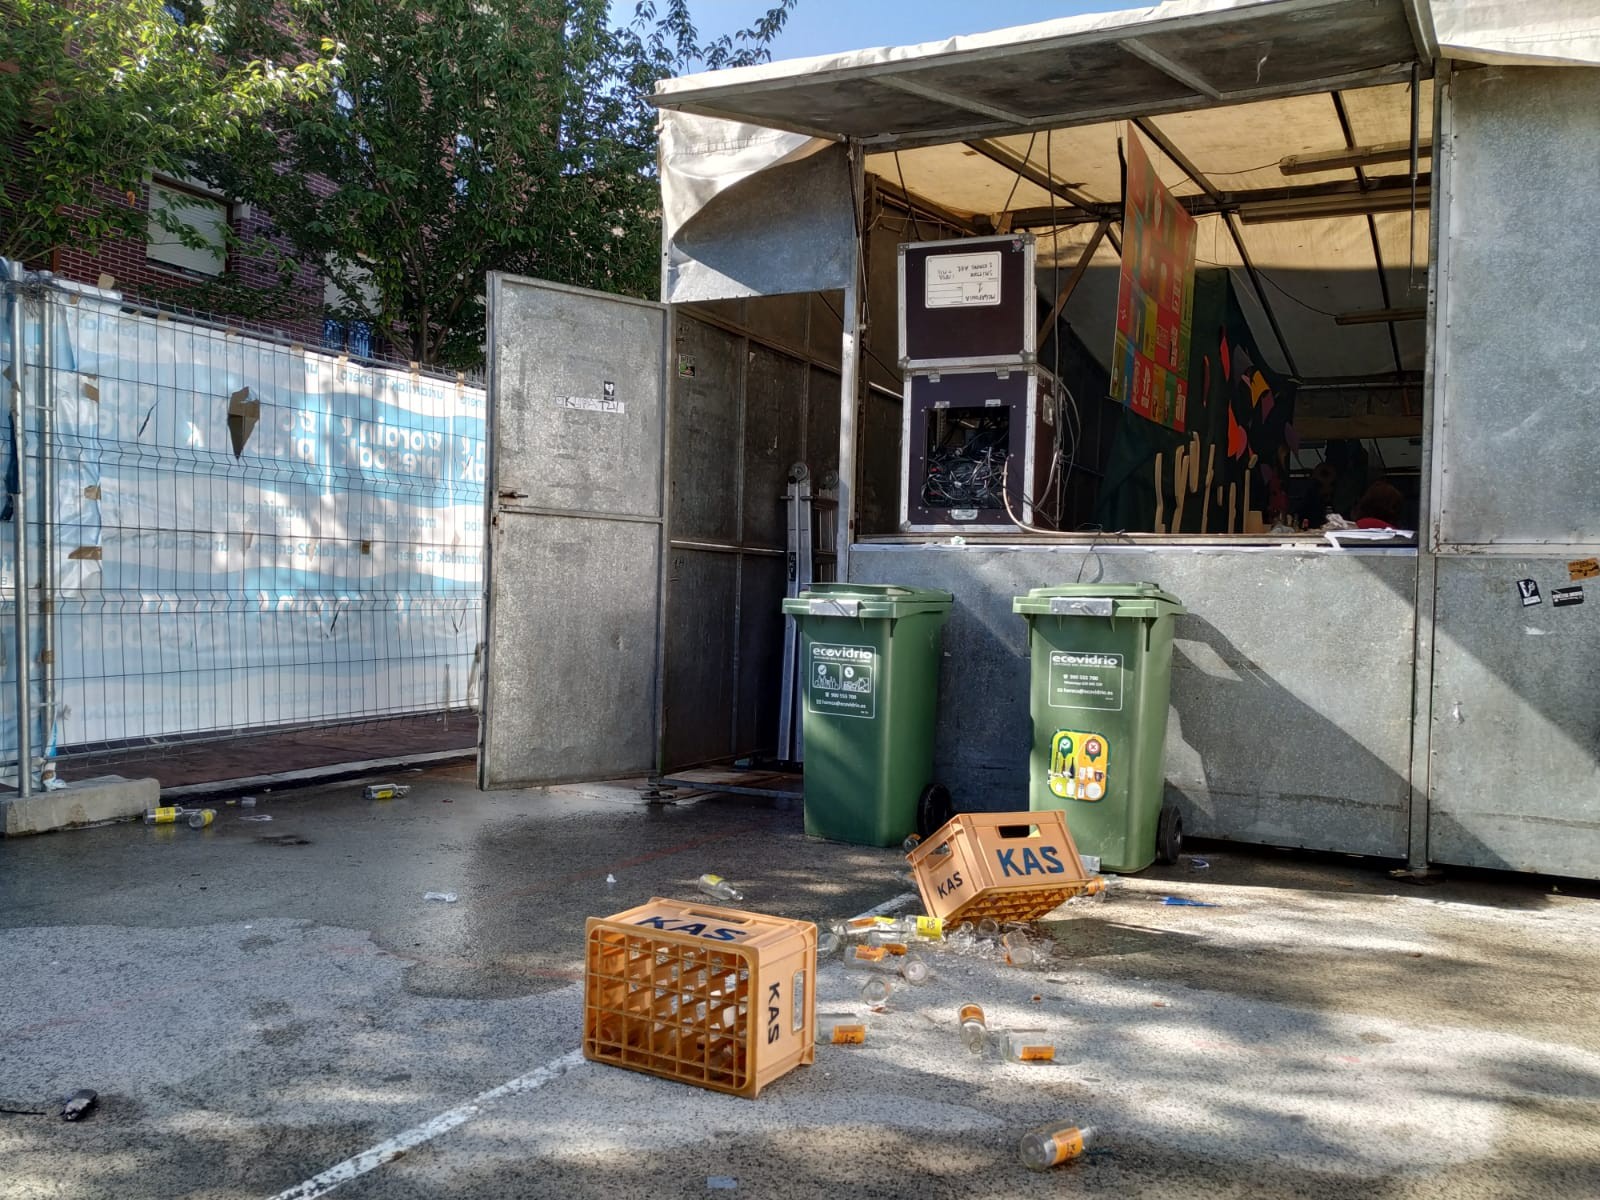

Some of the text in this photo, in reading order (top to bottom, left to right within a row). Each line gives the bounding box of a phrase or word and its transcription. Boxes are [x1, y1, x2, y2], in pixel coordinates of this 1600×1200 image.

[812, 646, 873, 659] ecovidrio
[1052, 654, 1118, 666] ecovidrio
[996, 845, 1065, 878] KAS
[937, 871, 964, 899] KAS
[635, 915, 747, 943] KAS
[767, 982, 781, 1046] KAS
